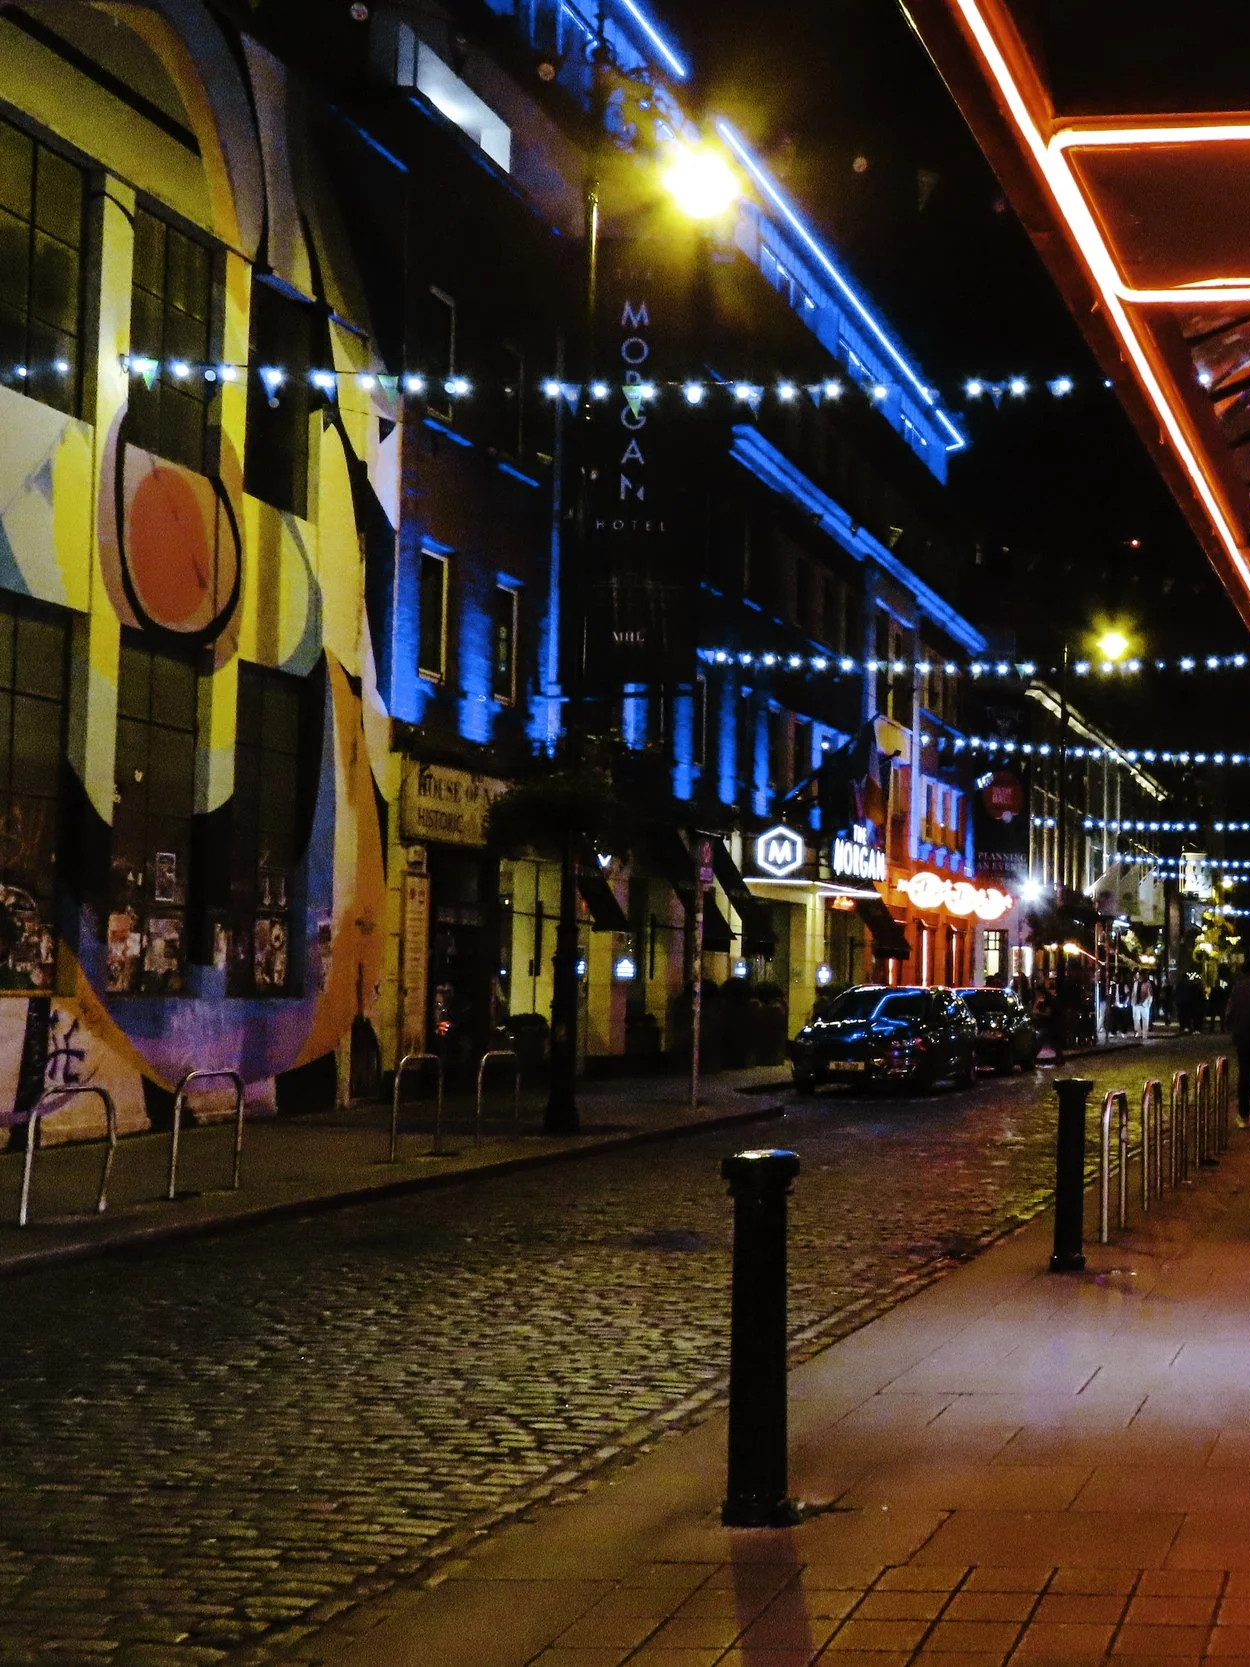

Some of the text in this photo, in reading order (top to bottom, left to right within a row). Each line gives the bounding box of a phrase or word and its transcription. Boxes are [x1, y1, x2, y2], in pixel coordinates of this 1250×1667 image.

[595, 519, 666, 532] HOTEL
[418, 776, 460, 803] HOUSE
[418, 807, 463, 833] HISTORIC
[853, 824, 867, 846] THE
[768, 839, 792, 865] M
[833, 837, 885, 882] MORGAN
[977, 852, 1027, 863] PLANNING
